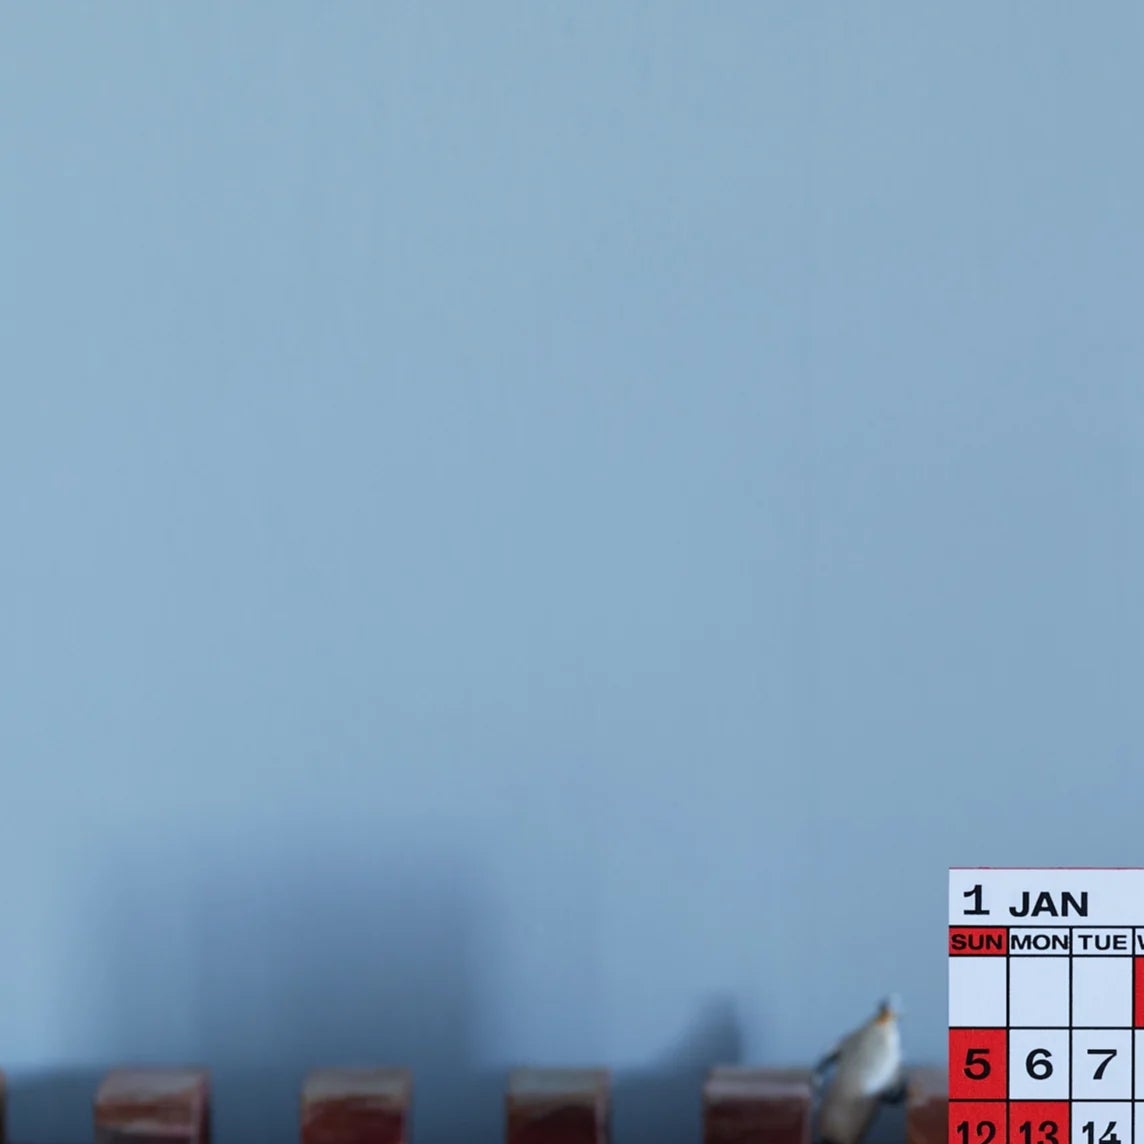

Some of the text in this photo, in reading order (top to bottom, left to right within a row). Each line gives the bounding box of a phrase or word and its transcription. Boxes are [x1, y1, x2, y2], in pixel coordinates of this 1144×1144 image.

[963, 884, 990, 915] 1
[1009, 891, 1088, 917] JAN
[951, 933, 1003, 951] SUN
[1010, 934, 1069, 951] MON
[1077, 934, 1127, 951] TUE
[963, 1048, 991, 1081] 5
[1025, 1048, 1053, 1081] 6
[1087, 1049, 1117, 1080] 7
